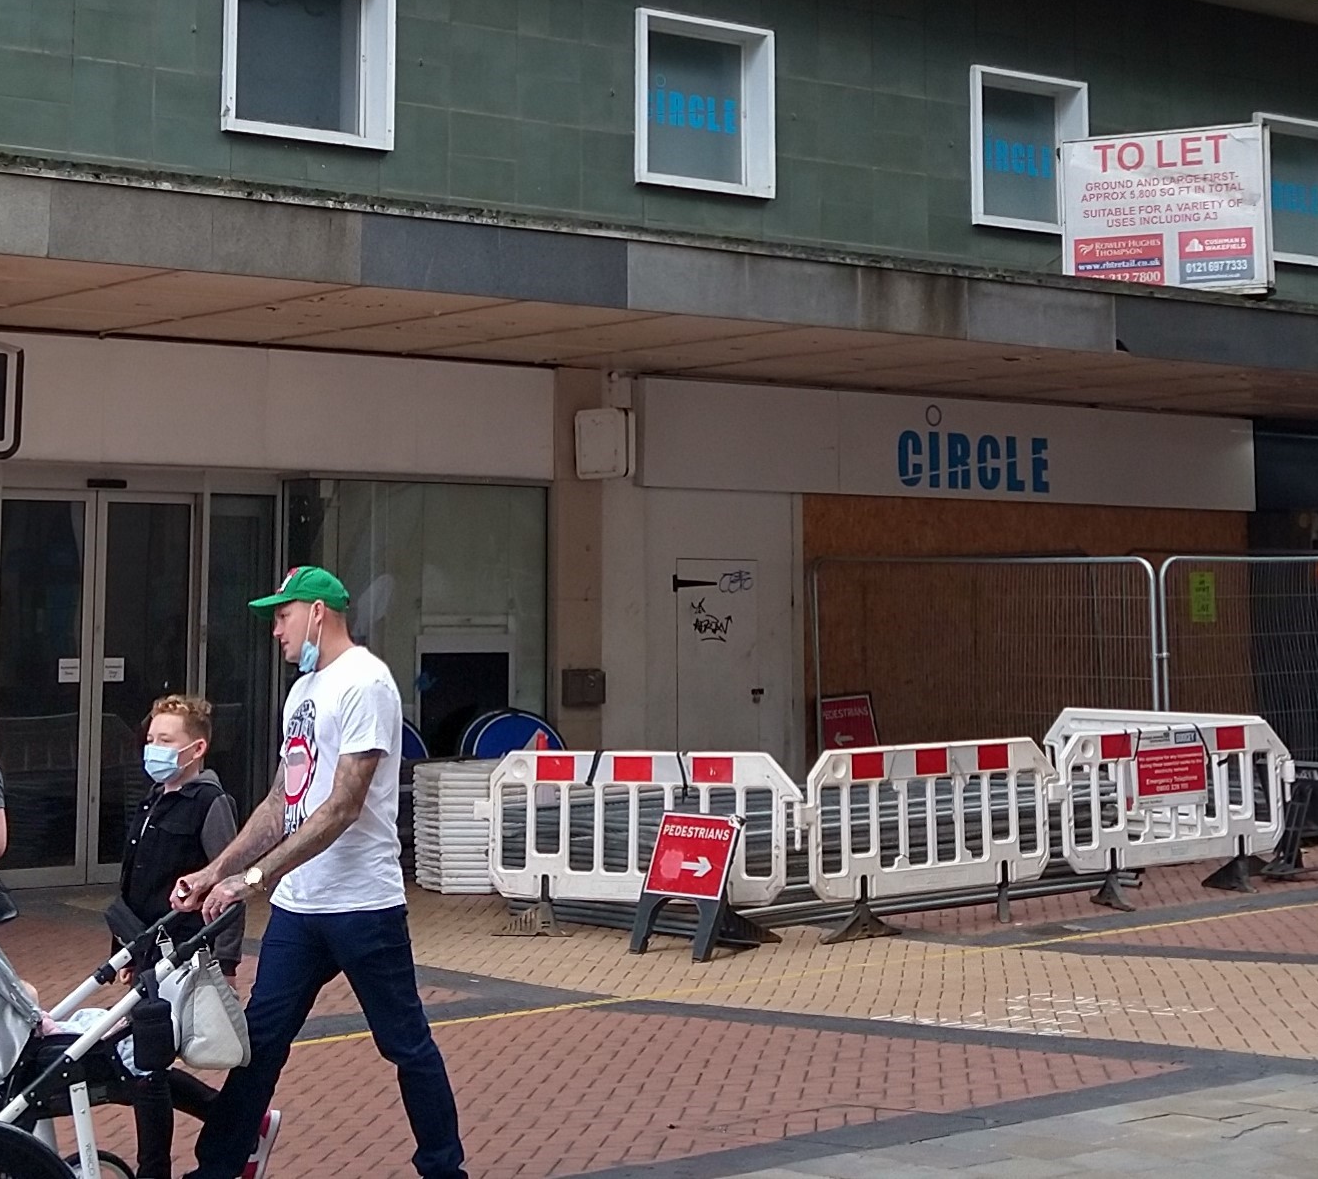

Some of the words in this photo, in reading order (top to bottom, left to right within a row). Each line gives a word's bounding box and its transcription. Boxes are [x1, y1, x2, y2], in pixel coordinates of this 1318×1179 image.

[1093, 141, 1144, 173] TO
[1156, 134, 1228, 169] LET
[1085, 180, 1132, 192] GROUND
[1136, 177, 1160, 188] AND
[1162, 174, 1201, 186] LARGE
[1081, 190, 1127, 203] APPROX
[1129, 189, 1157, 200] 5,800
[1160, 187, 1175, 197] SQ
[1178, 186, 1190, 195] FT
[1194, 185, 1205, 194] IN
[1208, 183, 1245, 193] TOTAL
[1083, 206, 1136, 219] SUITABLE
[1138, 204, 1162, 214] FOR
[1164, 203, 1173, 212] A
[1176, 199, 1224, 212] VARIETY
[1227, 198, 1244, 208] OF
[1106, 218, 1136, 228] USES
[1140, 213, 1201, 226] INCLUDING
[1203, 212, 1218, 221] A3
[1133, 271, 1161, 282] 7800
[662, 824, 730, 841] PEDESTRIANS
